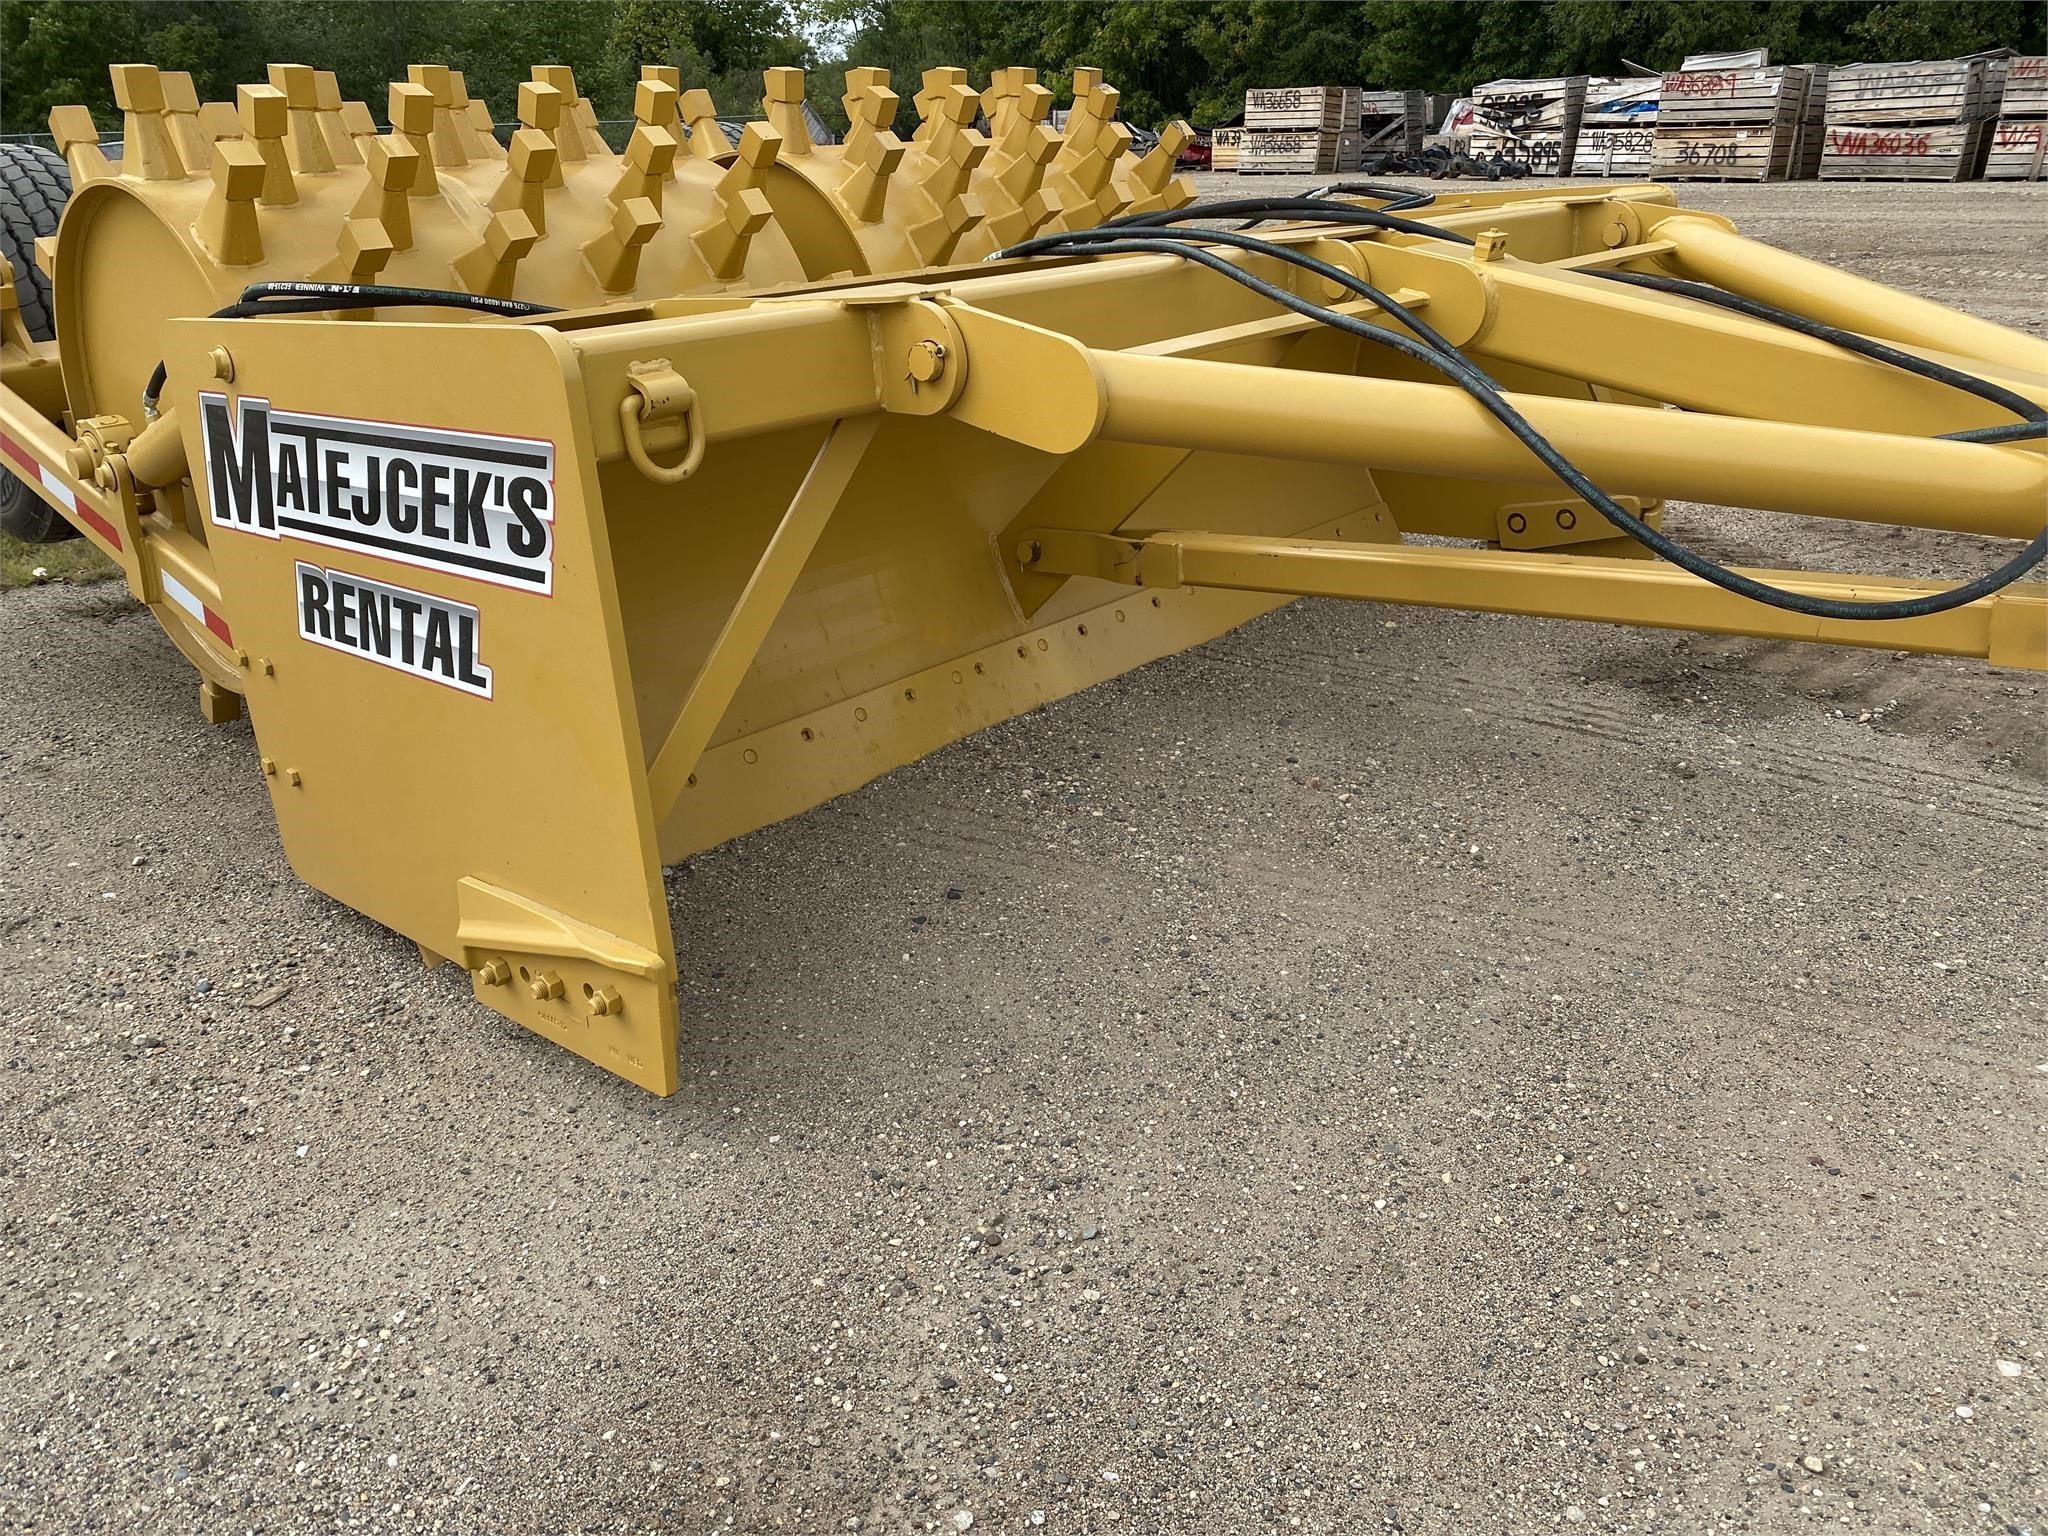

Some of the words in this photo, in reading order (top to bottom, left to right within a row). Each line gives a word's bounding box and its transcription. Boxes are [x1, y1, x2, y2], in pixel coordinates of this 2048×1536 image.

[1252, 90, 1301, 110] WA36658
[1675, 141, 1738, 167] 36708
[1833, 129, 1934, 156] WA36036
[296, 283, 325, 292] WINNER
[205, 403, 548, 559] MATEJCEK'S
[301, 573, 487, 689] RENTAL
